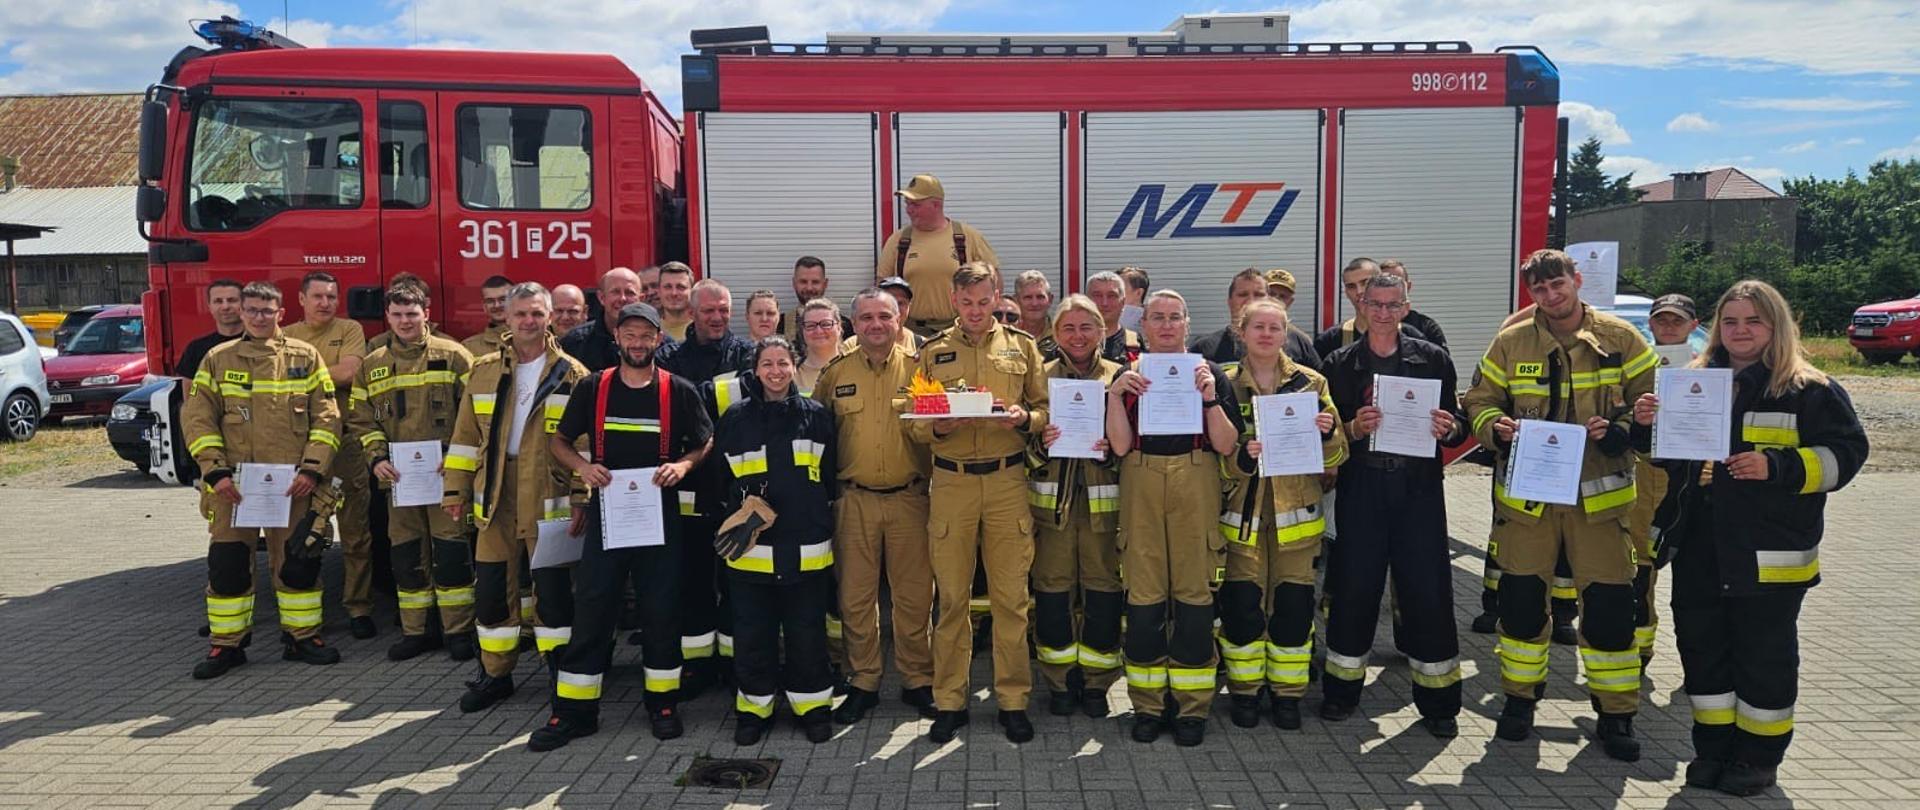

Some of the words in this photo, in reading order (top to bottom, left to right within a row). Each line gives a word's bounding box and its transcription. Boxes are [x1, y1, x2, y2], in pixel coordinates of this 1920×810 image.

[1412, 72, 1441, 91] 998
[1460, 72, 1487, 91] 112
[459, 220, 519, 258] 361
[548, 221, 592, 259] 25
[304, 256, 326, 264] TGM
[329, 256, 366, 264] 18.320
[371, 368, 386, 378] OSP
[1519, 364, 1540, 374] OSP
